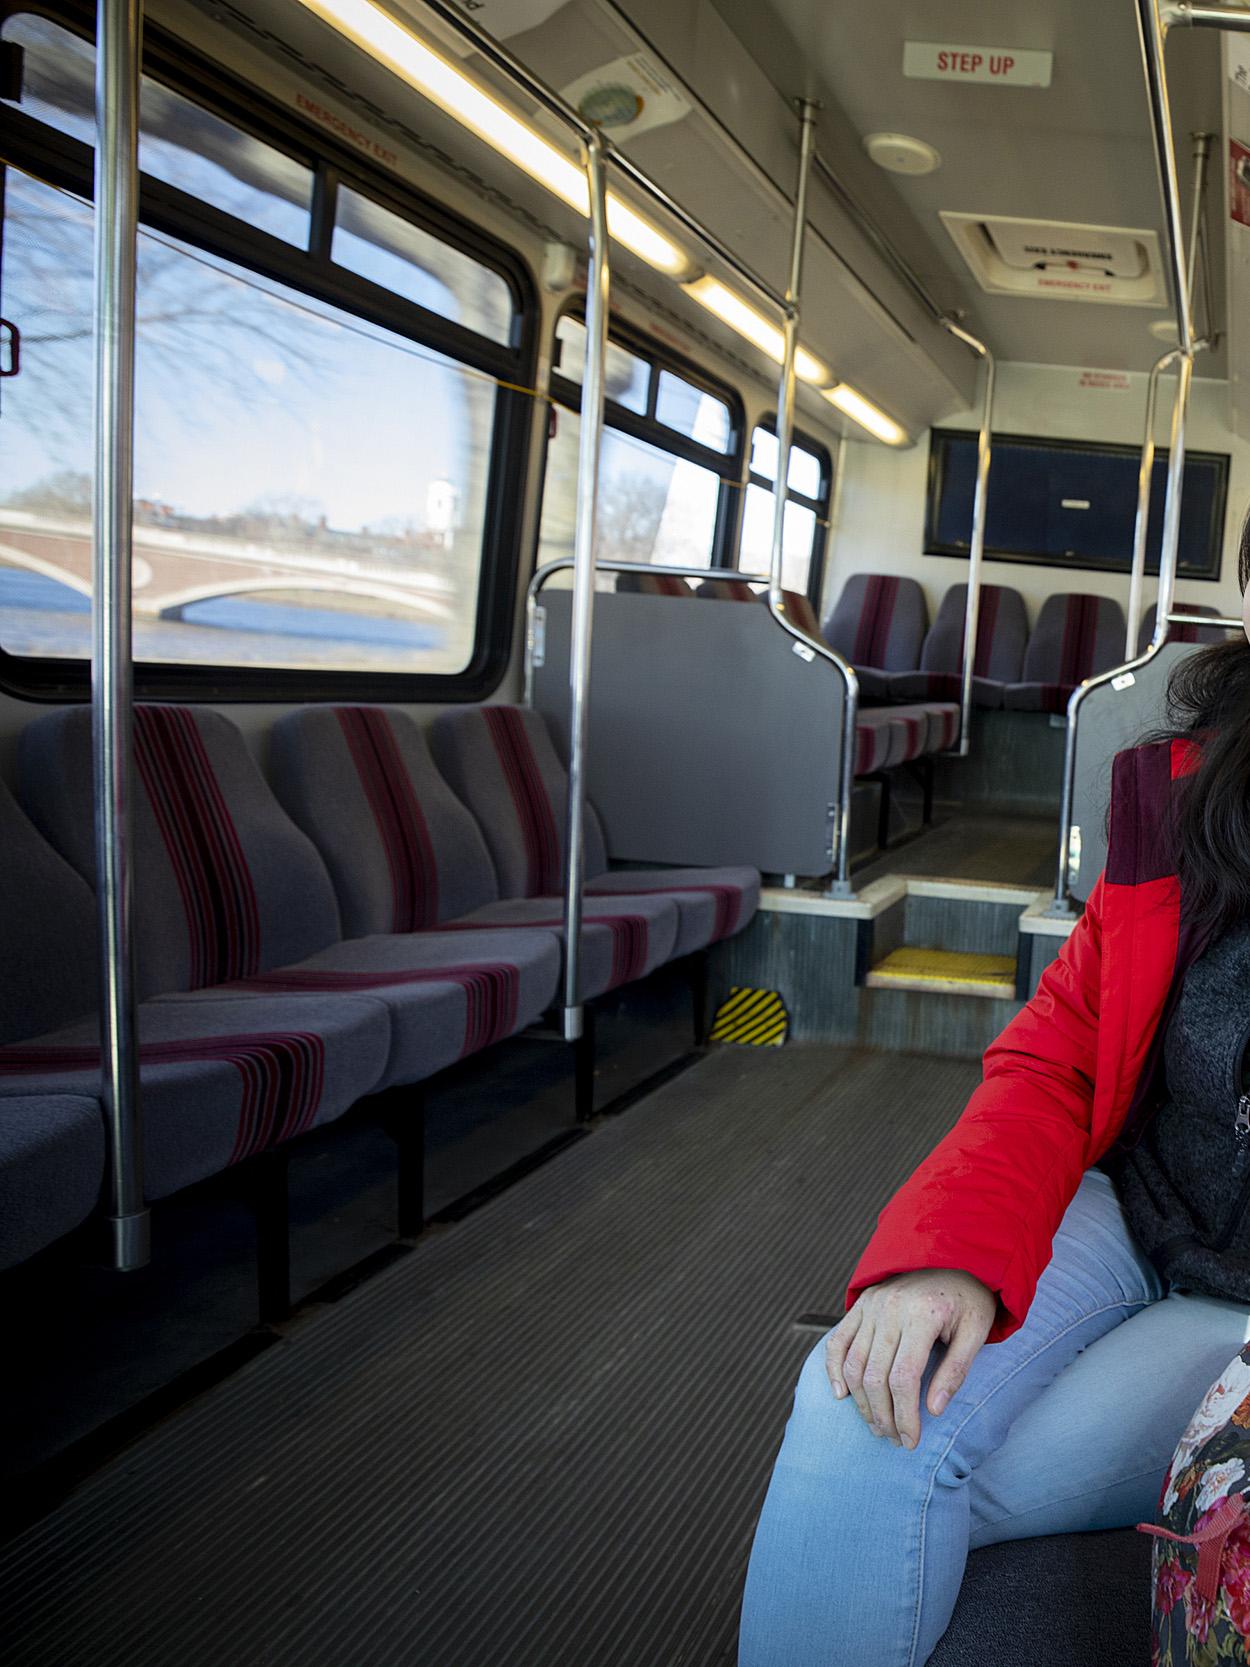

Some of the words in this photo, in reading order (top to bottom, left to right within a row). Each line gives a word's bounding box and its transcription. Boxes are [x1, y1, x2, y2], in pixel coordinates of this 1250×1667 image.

[937, 51, 983, 73] STEP
[989, 55, 1015, 76] UP
[1234, 64, 1248, 85] The
[295, 92, 371, 149] EMERGENCY
[373, 143, 397, 166] EXIT
